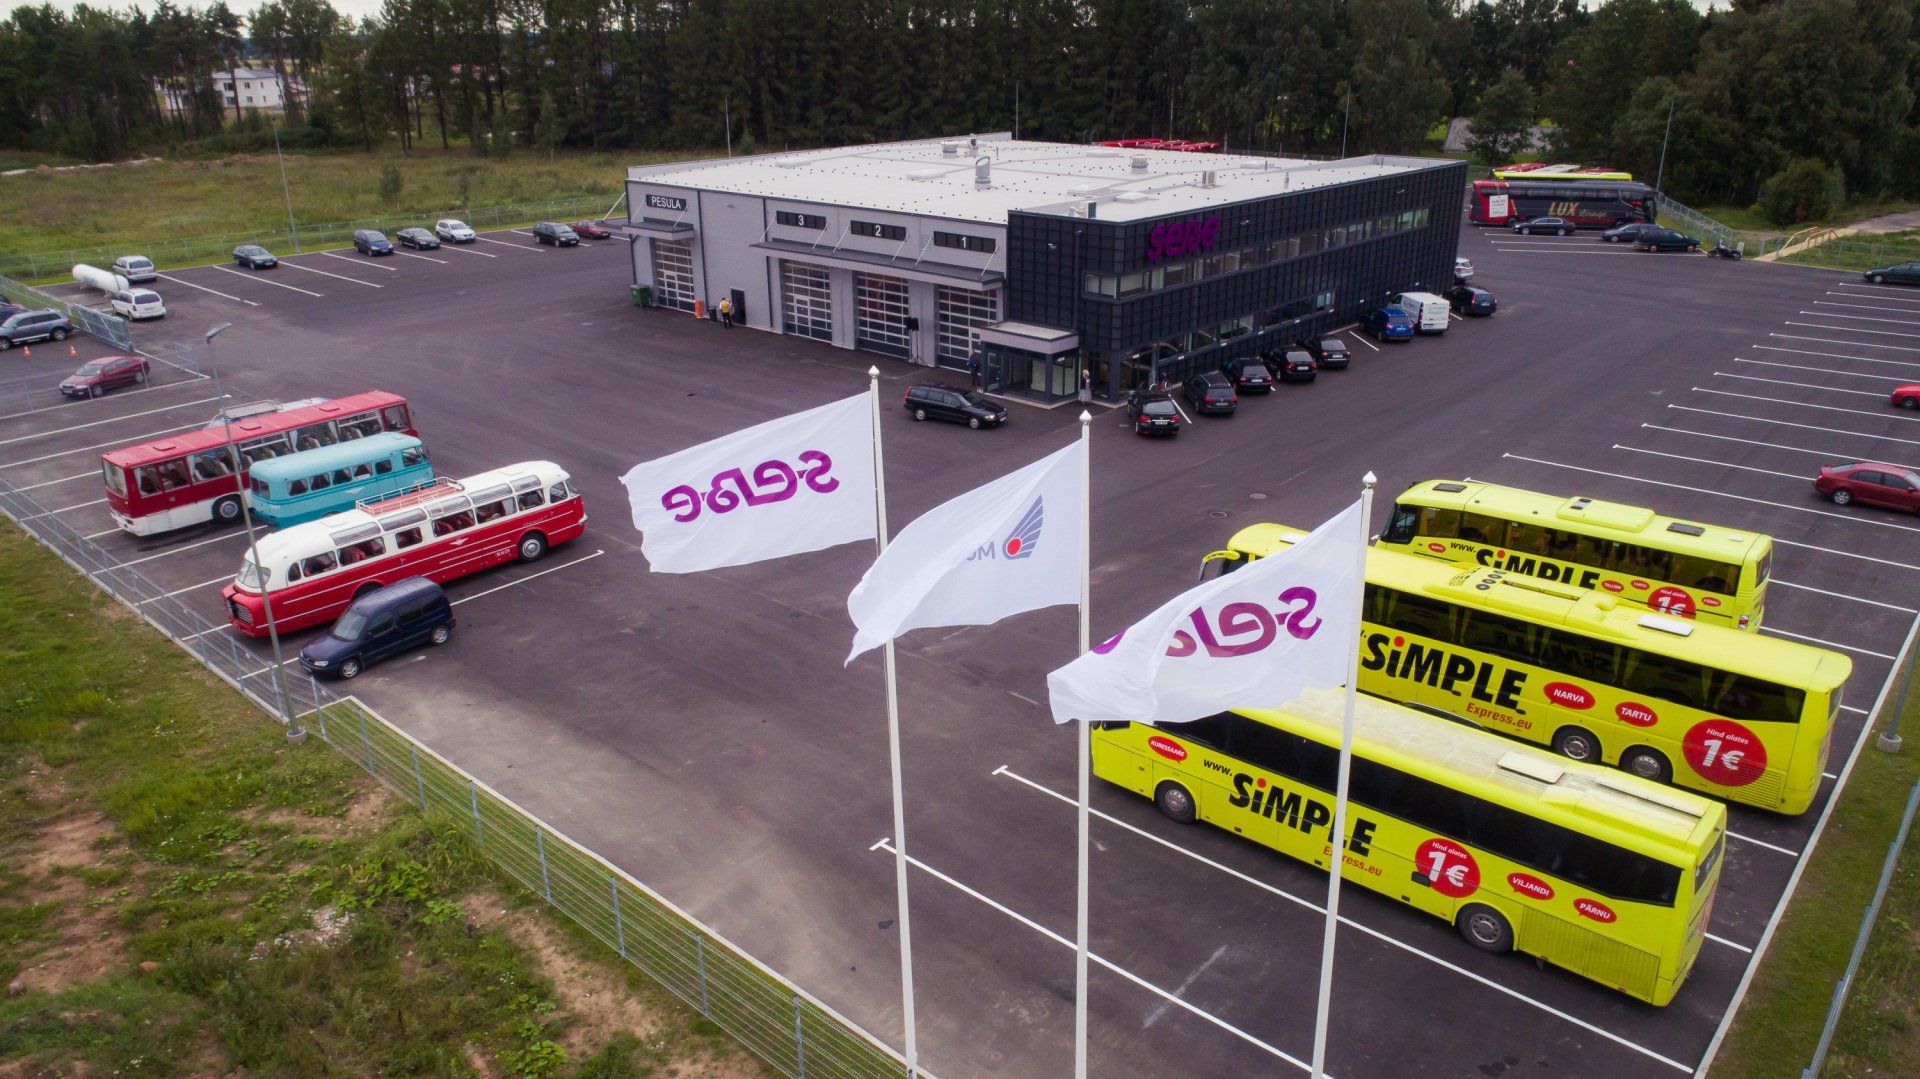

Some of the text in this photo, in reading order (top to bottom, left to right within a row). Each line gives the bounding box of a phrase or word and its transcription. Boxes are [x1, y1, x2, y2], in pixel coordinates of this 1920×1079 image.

[651, 196, 681, 210] PESULA
[1549, 201, 1579, 216] LUX
[798, 214, 804, 226] 3
[875, 224, 881, 236] 2
[1450, 542, 1476, 553] www.
[1361, 633, 1528, 711] SiMPLE
[1553, 688, 1585, 704] NARVA
[1466, 702, 1533, 730] Express.eu
[1621, 706, 1652, 722] TARTU
[1706, 728, 1749, 745] Hind alates
[1150, 740, 1185, 757] KURESSAARE
[1702, 739, 1745, 770] 1€
[1203, 759, 1232, 776] www.
[1432, 841, 1467, 859] Hind alates
[1323, 845, 1382, 877] Eress.eu
[1428, 851, 1470, 888] 1€
[1512, 877, 1550, 897] VILJANDI
[1579, 902, 1611, 920] PÄRNU
